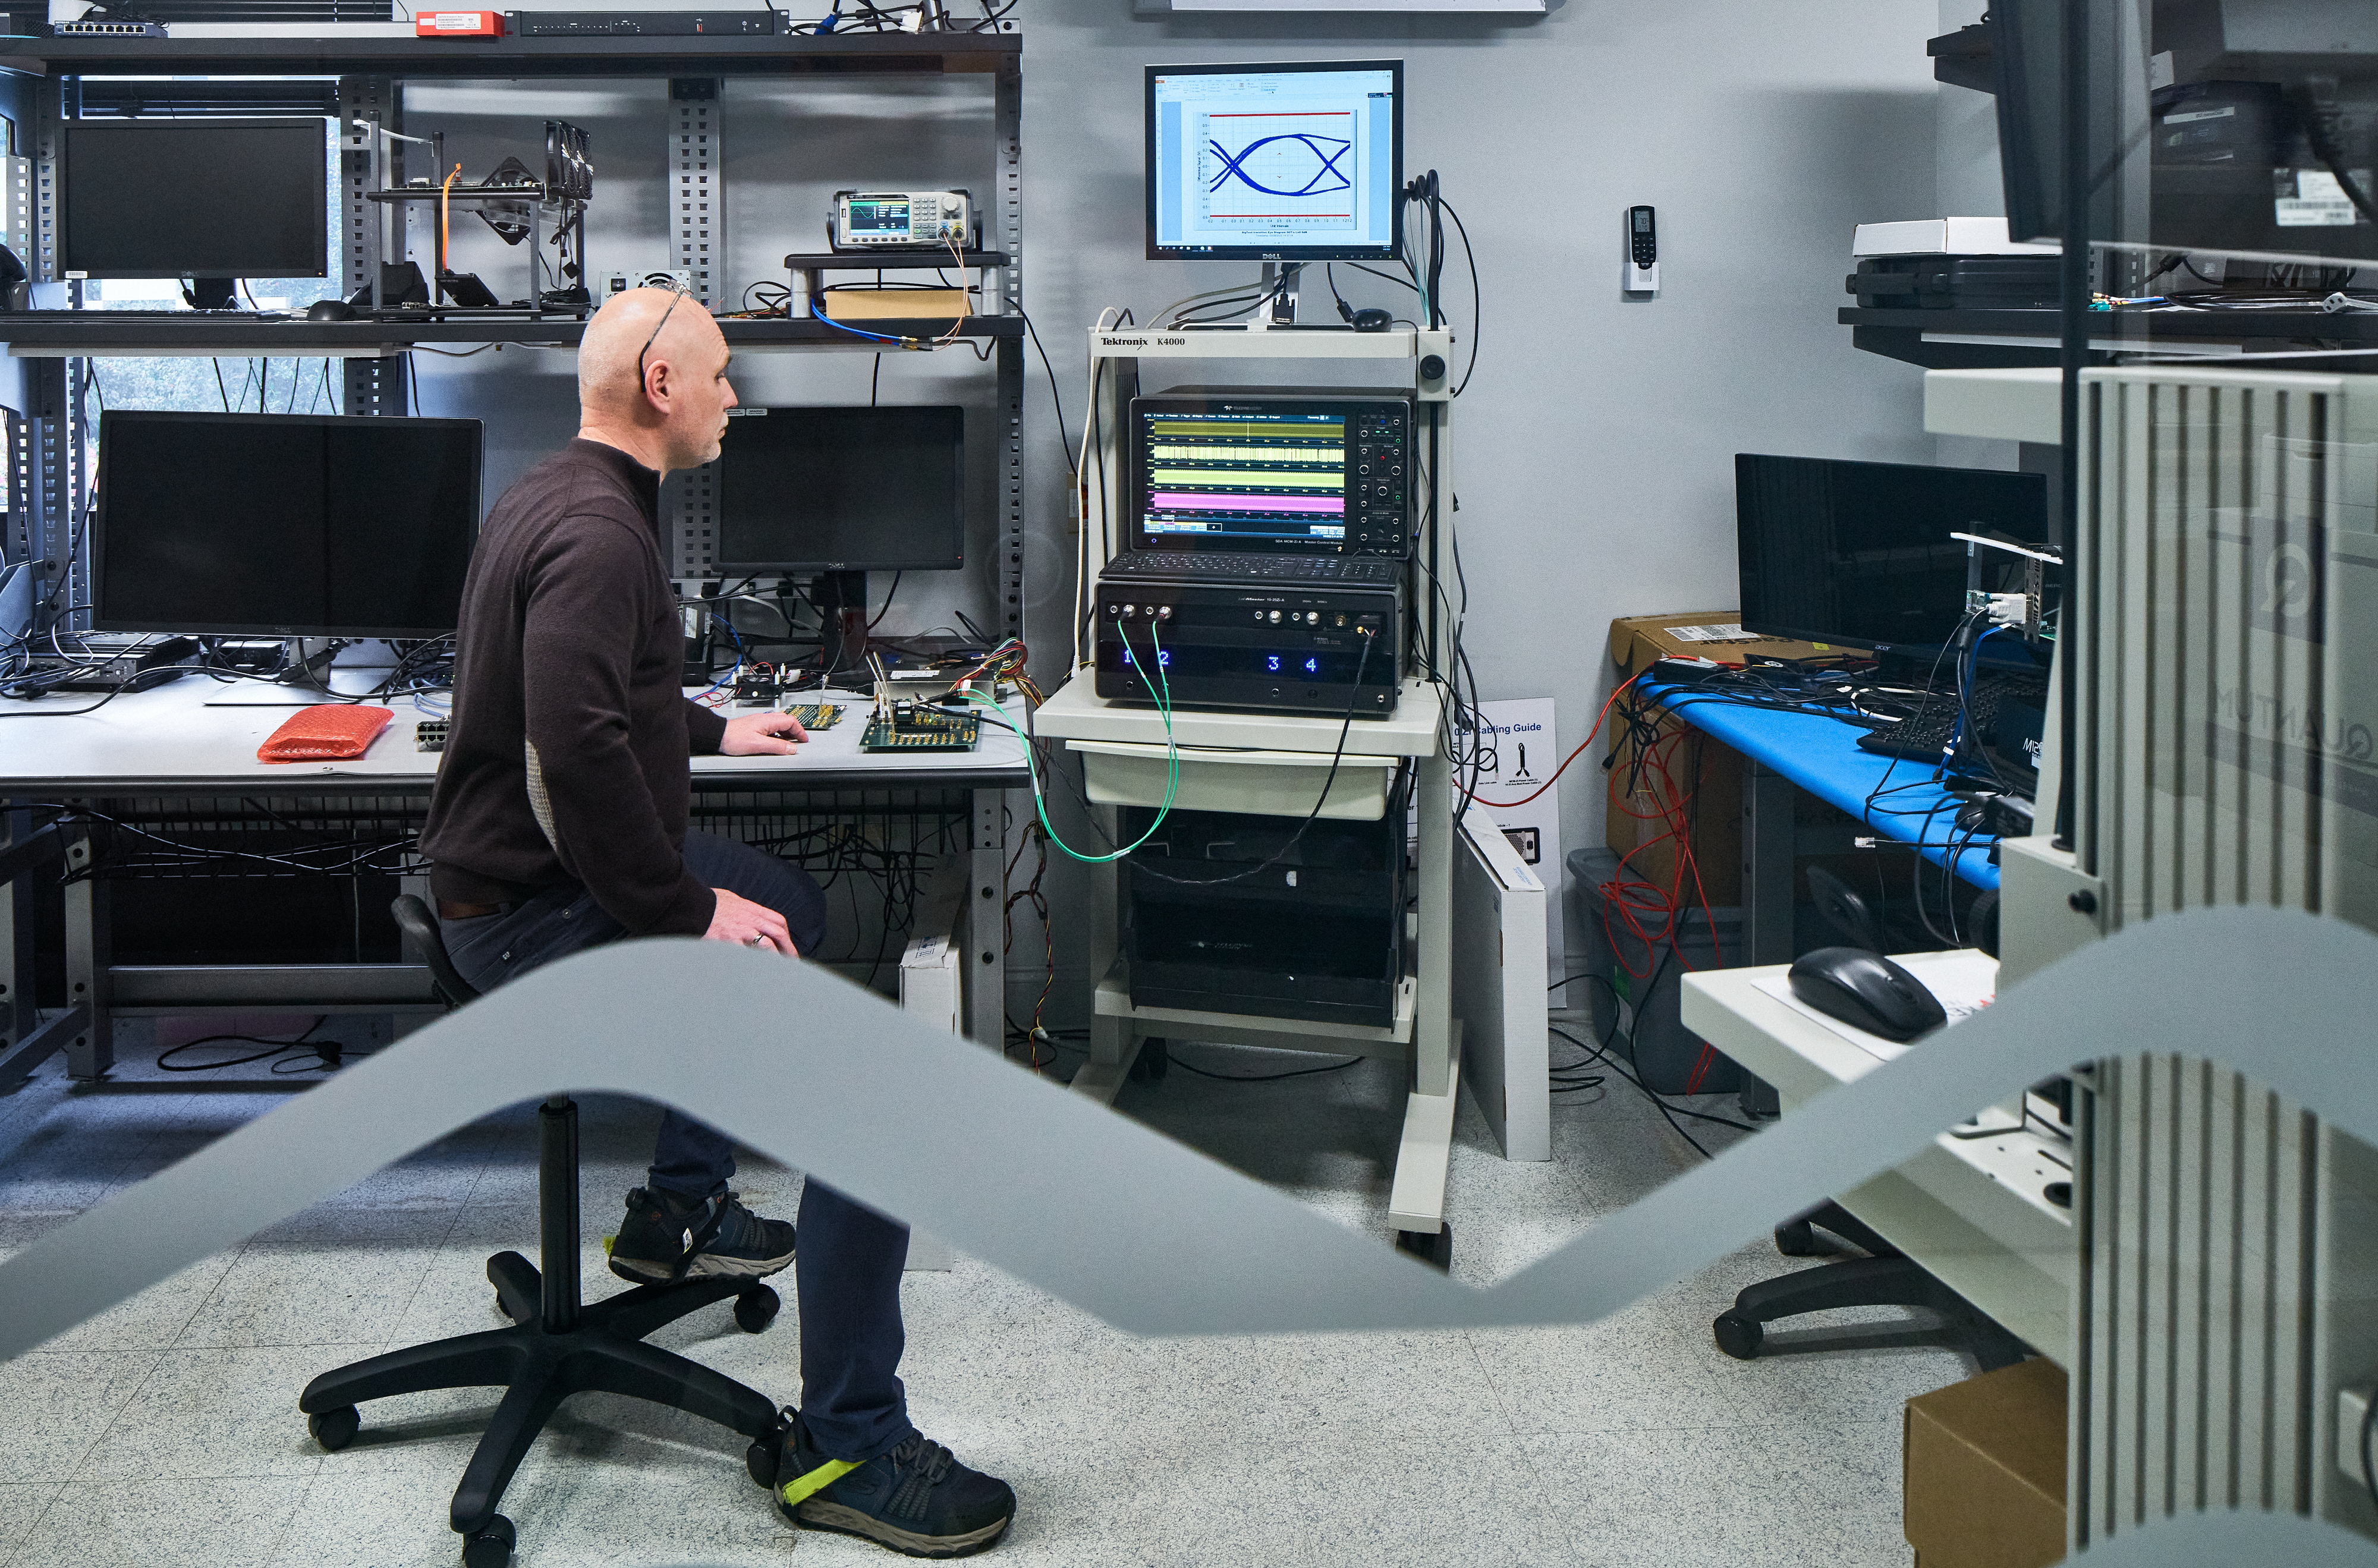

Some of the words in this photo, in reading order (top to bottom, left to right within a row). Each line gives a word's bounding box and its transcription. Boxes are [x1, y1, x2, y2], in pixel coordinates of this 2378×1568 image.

[1100, 338, 1149, 351] Tektronix
[1124, 650, 1131, 663] 1
[1159, 651, 1169, 665] 2
[1268, 656, 1279, 670] 3
[1306, 657, 1316, 672] 4
[1513, 723, 1542, 732] Guide
